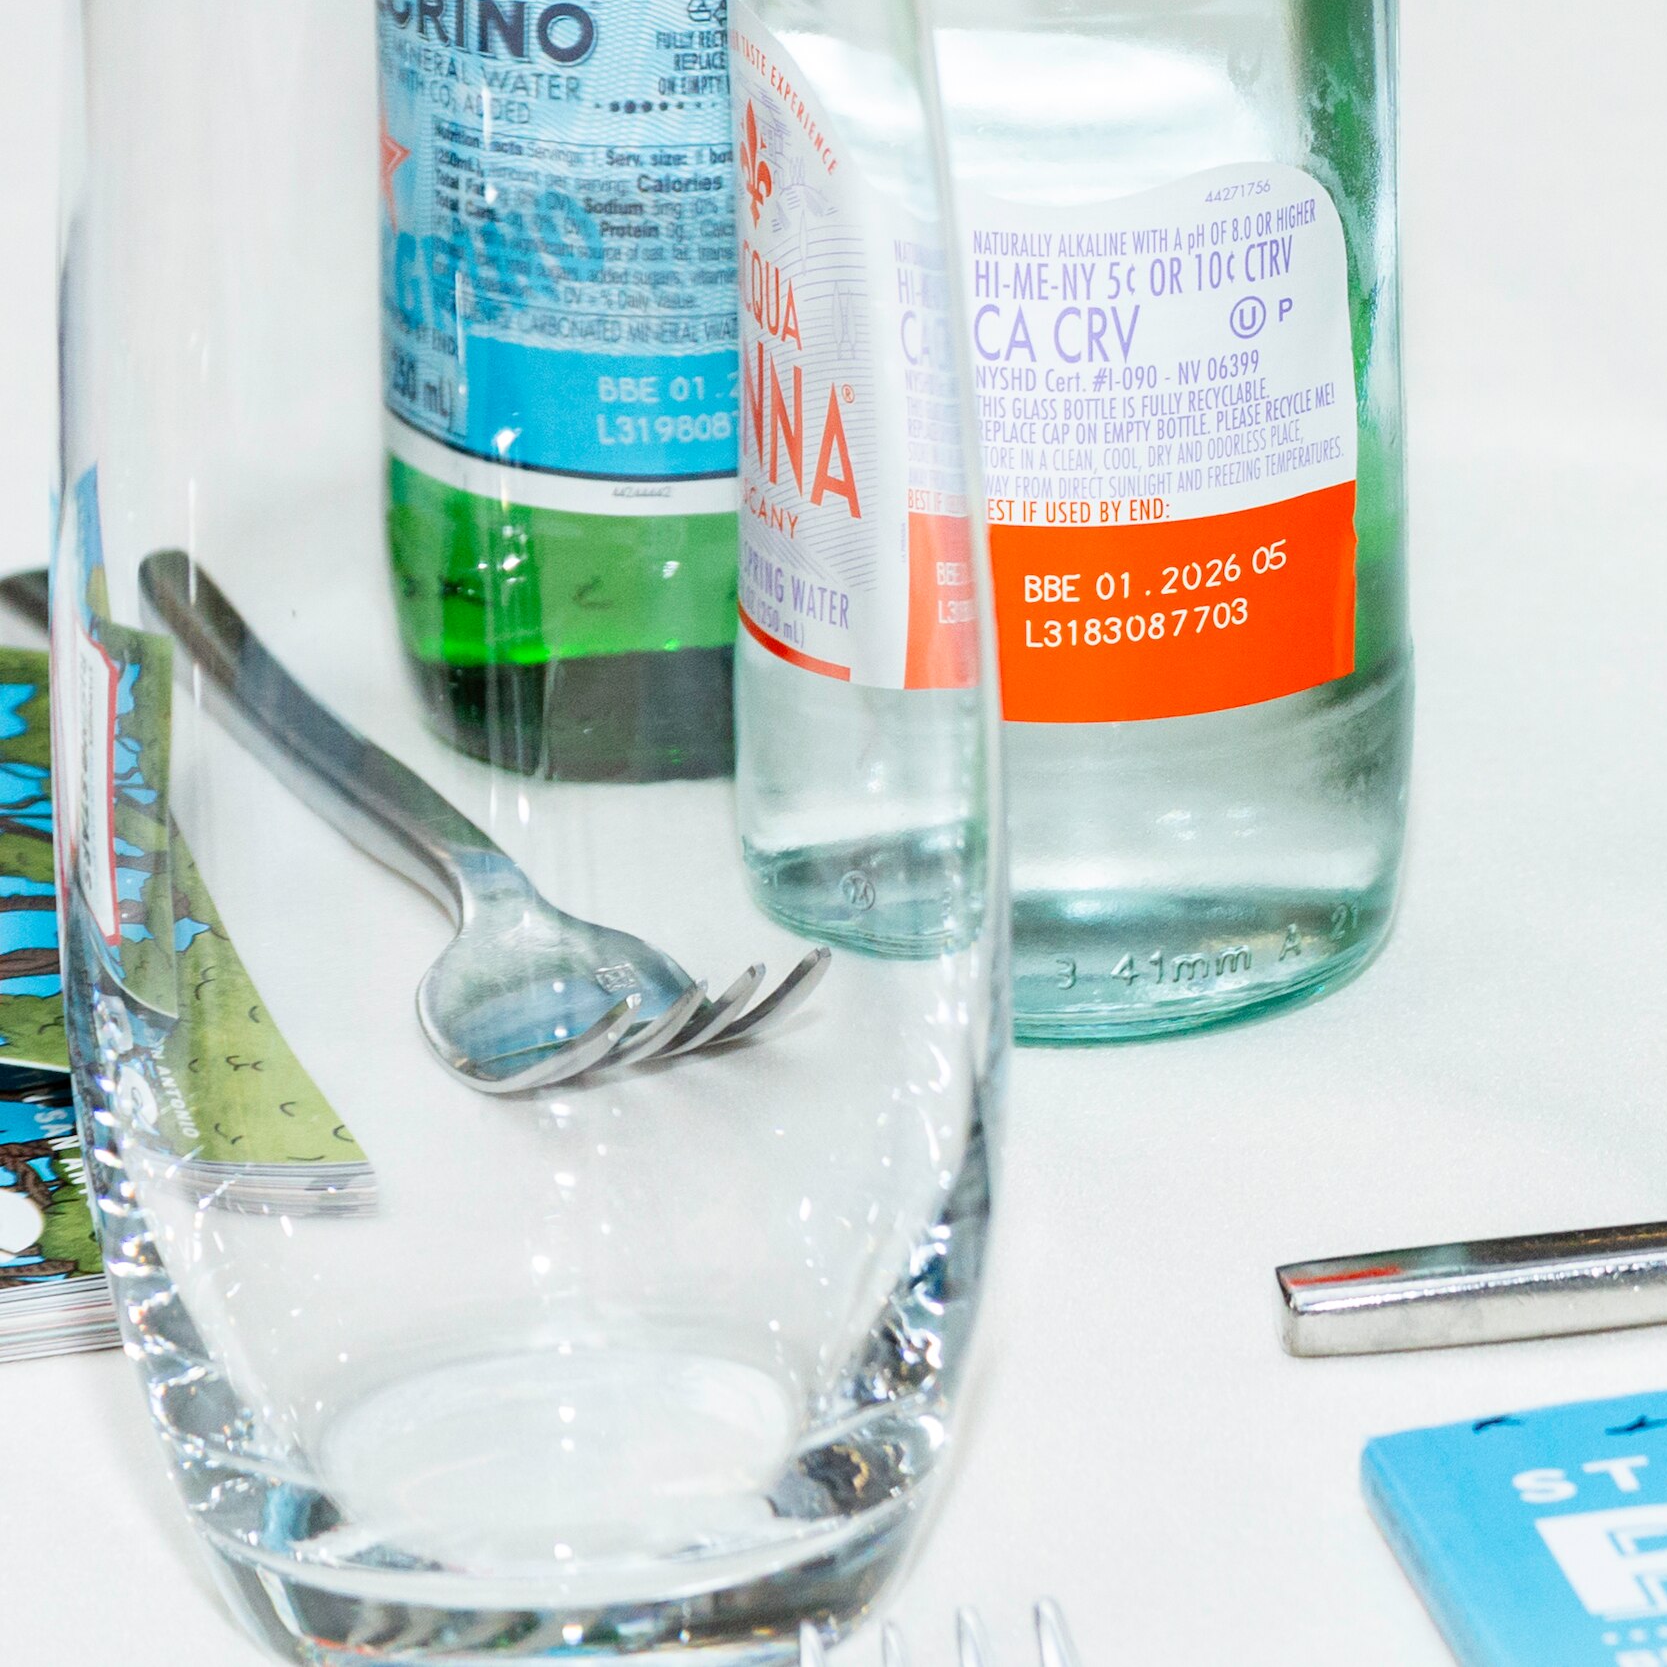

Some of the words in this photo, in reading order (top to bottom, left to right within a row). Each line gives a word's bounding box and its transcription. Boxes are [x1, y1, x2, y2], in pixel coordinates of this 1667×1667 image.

[769, 64, 839, 176] EXPERIENCE
[1204, 180, 1272, 203] 44271756
[973, 230, 1053, 258] NATURALLY
[1058, 232, 1128, 258] ALKALINE
[1132, 228, 1169, 255] WITH
[1173, 227, 1184, 252] A
[1187, 223, 1206, 256] pH
[1210, 220, 1228, 246] OF
[1231, 215, 1252, 242] 8.0
[1255, 211, 1273, 238] OR
[1276, 197, 1317, 234] HIGHER
[974, 259, 1097, 302] HI-ME-NY
[1150, 256, 1184, 298] OR
[1244, 234, 1294, 284] CTRV
[973, 302, 1038, 363] CA
[1053, 303, 1142, 365] CRV
[1278, 296, 1294, 324] P
[598, 374, 661, 405] BBE
[974, 364, 1038, 392] NYSHD
[1044, 368, 1088, 394] Cert.
[1177, 359, 1202, 387] NV
[1206, 348, 1260, 383] 06399
[1012, 397, 1058, 421] GLASS
[1063, 397, 1118, 422] BOTTLE
[1122, 396, 1136, 419] IS
[1141, 391, 1184, 419] FULLY
[1187, 377, 1271, 413] RECYCLABLE.
[1042, 422, 1070, 446] CAP
[1075, 422, 1098, 445] ON
[1104, 419, 1152, 444] EMPTY
[1156, 412, 1212, 441] BOTTLE.
[1216, 402, 1262, 433] PLEASE
[1265, 388, 1313, 423] RECYCLE
[1314, 381, 1336, 410] ME!
[1020, 447, 1034, 471] IN
[1103, 447, 1143, 474] COOL,
[1147, 444, 1174, 469] DRY
[1176, 439, 1203, 466] AND
[1206, 427, 1268, 461] ODORLESS
[1015, 476, 1053, 500] FROM
[1058, 476, 1104, 500] DIRECT
[1108, 471, 1174, 500] SUNLIGHT
[1176, 468, 1203, 494] AND
[1206, 457, 1262, 490] FREEZING
[1022, 500, 1038, 523] IF
[1045, 500, 1092, 524] USED
[1099, 499, 1122, 524] BY
[1128, 496, 1172, 523] END:
[1024, 573, 1081, 603] BBE
[1251, 538, 1288, 575] 05
[791, 574, 850, 630] WATER
[1025, 596, 1249, 648] L3183087703
